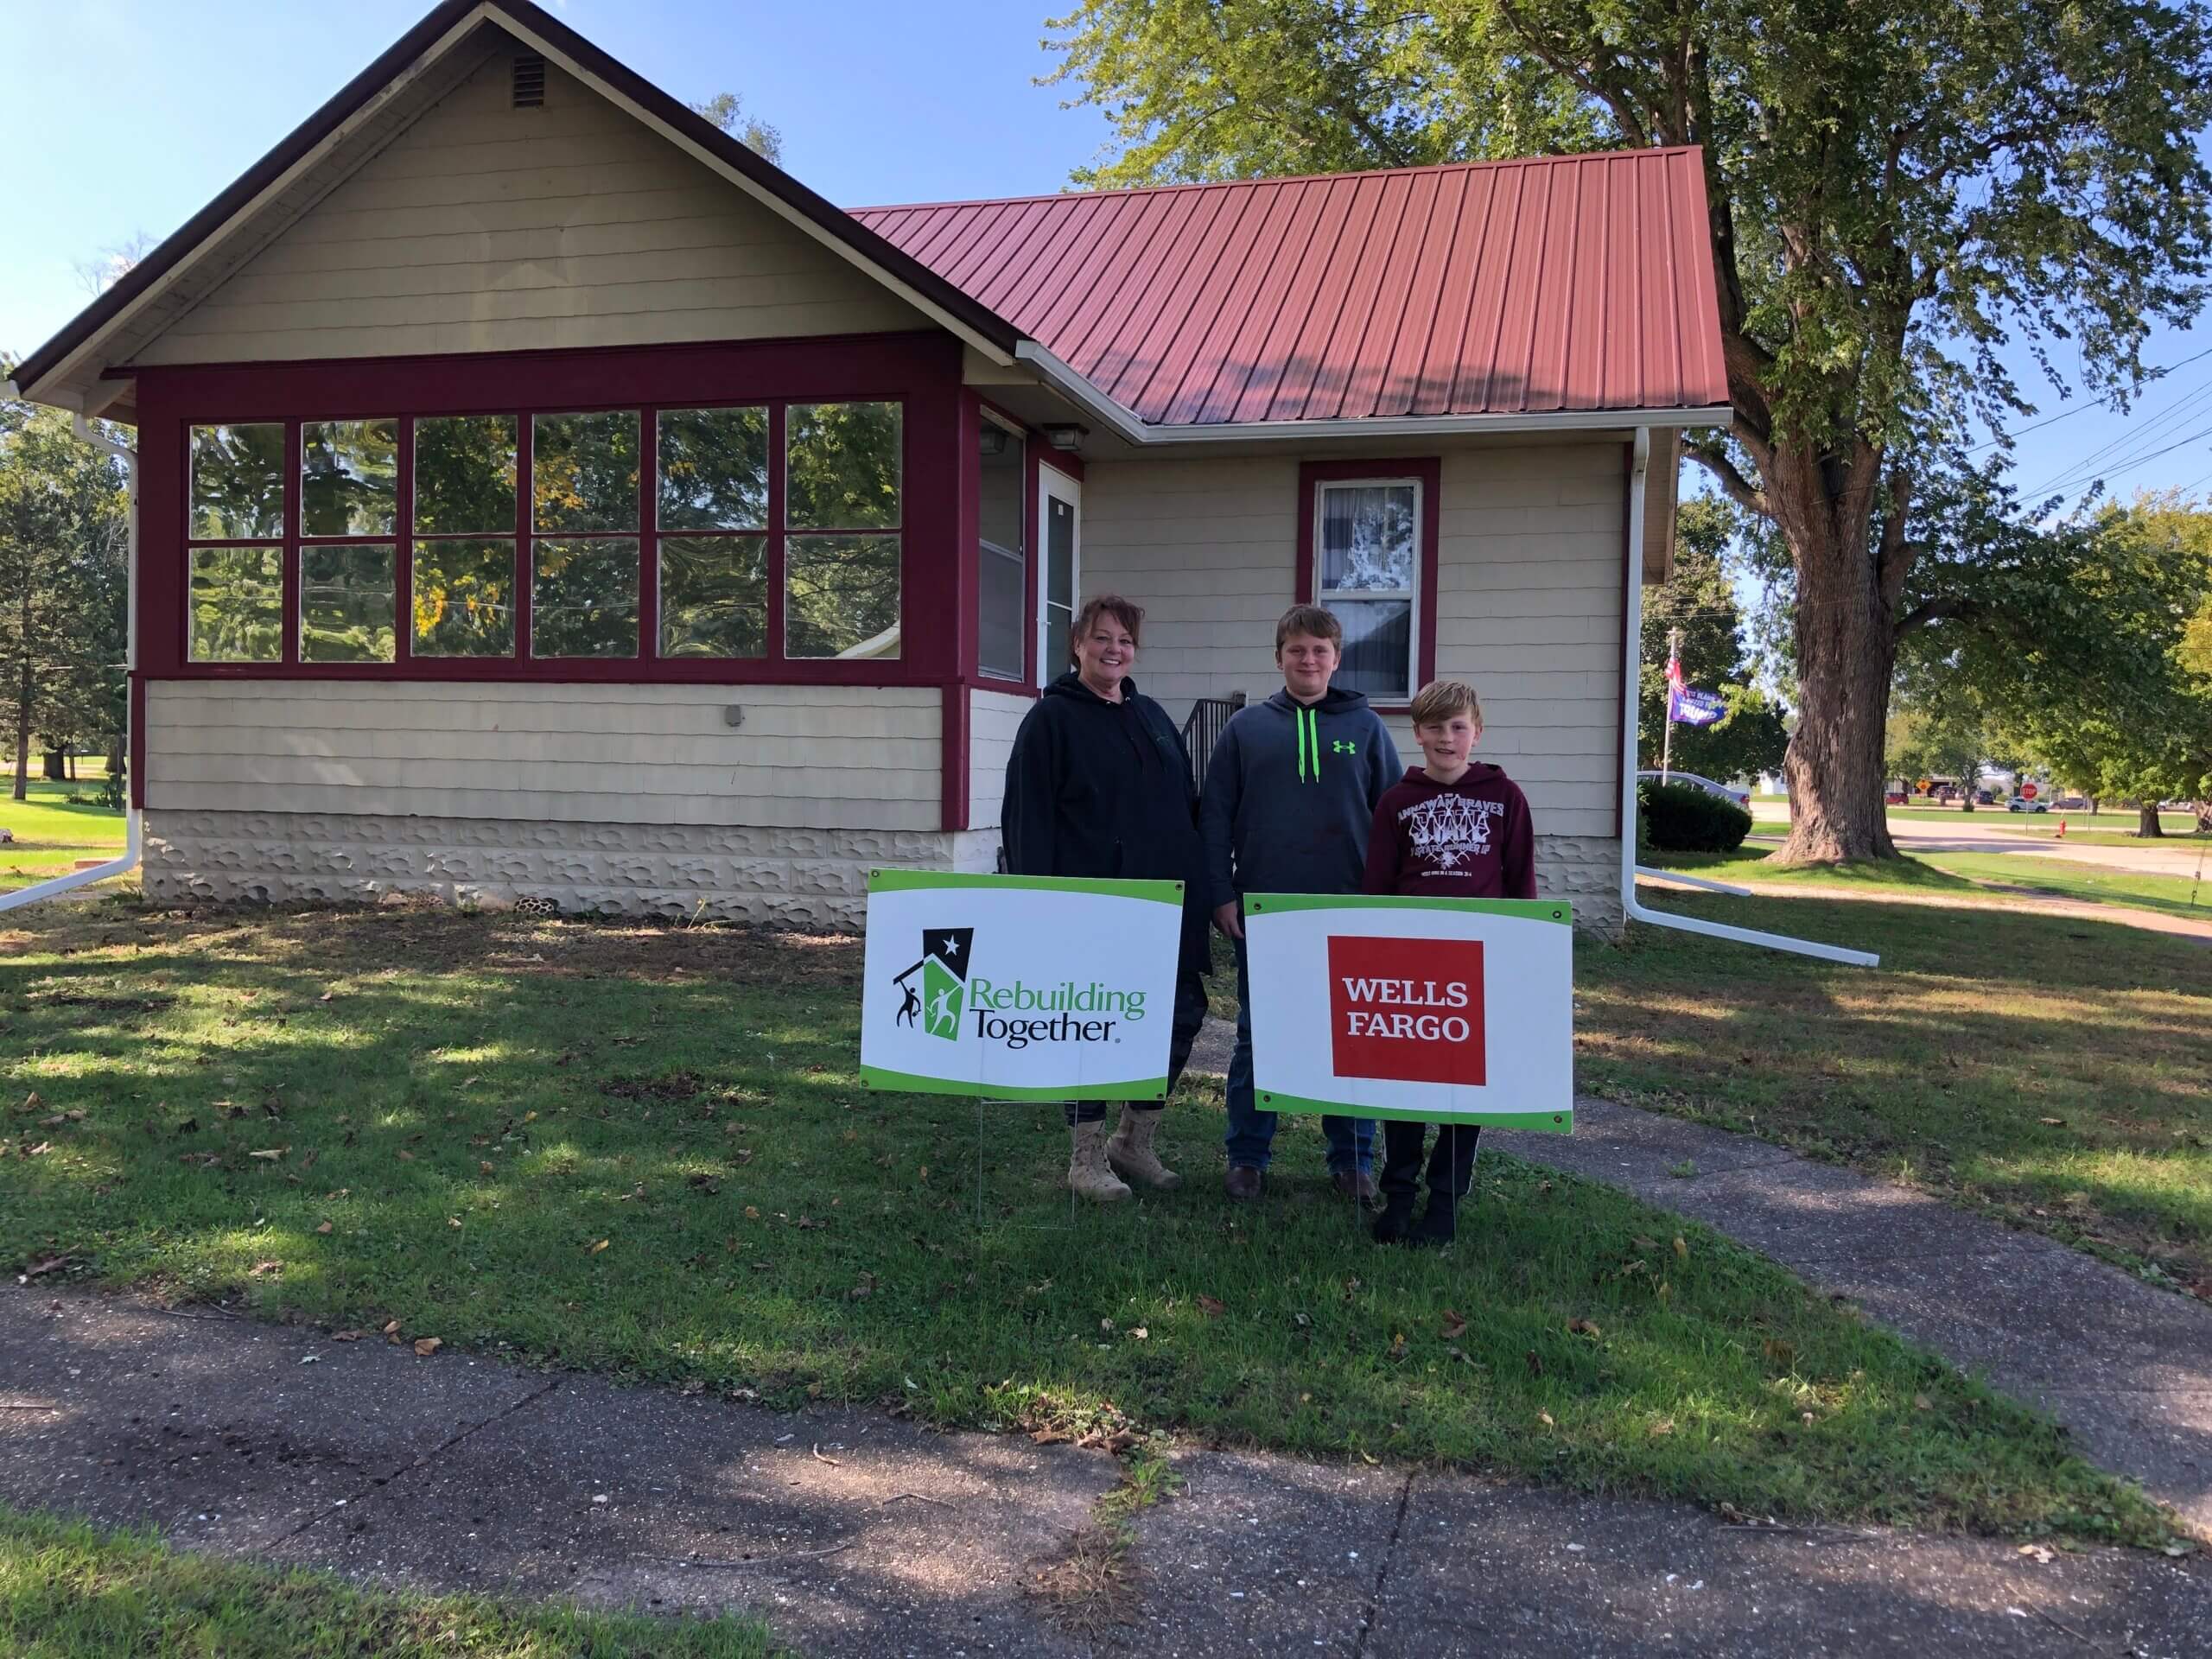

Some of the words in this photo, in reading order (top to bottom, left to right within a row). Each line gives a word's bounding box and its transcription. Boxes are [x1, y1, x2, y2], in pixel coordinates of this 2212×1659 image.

[1679, 702, 1718, 720] TRUMP
[1458, 798, 1504, 817] BRAVES
[969, 978, 1147, 1020] Rebuilding
[1342, 977, 1468, 1007] WELLS
[1347, 1012, 1470, 1042] FARGO
